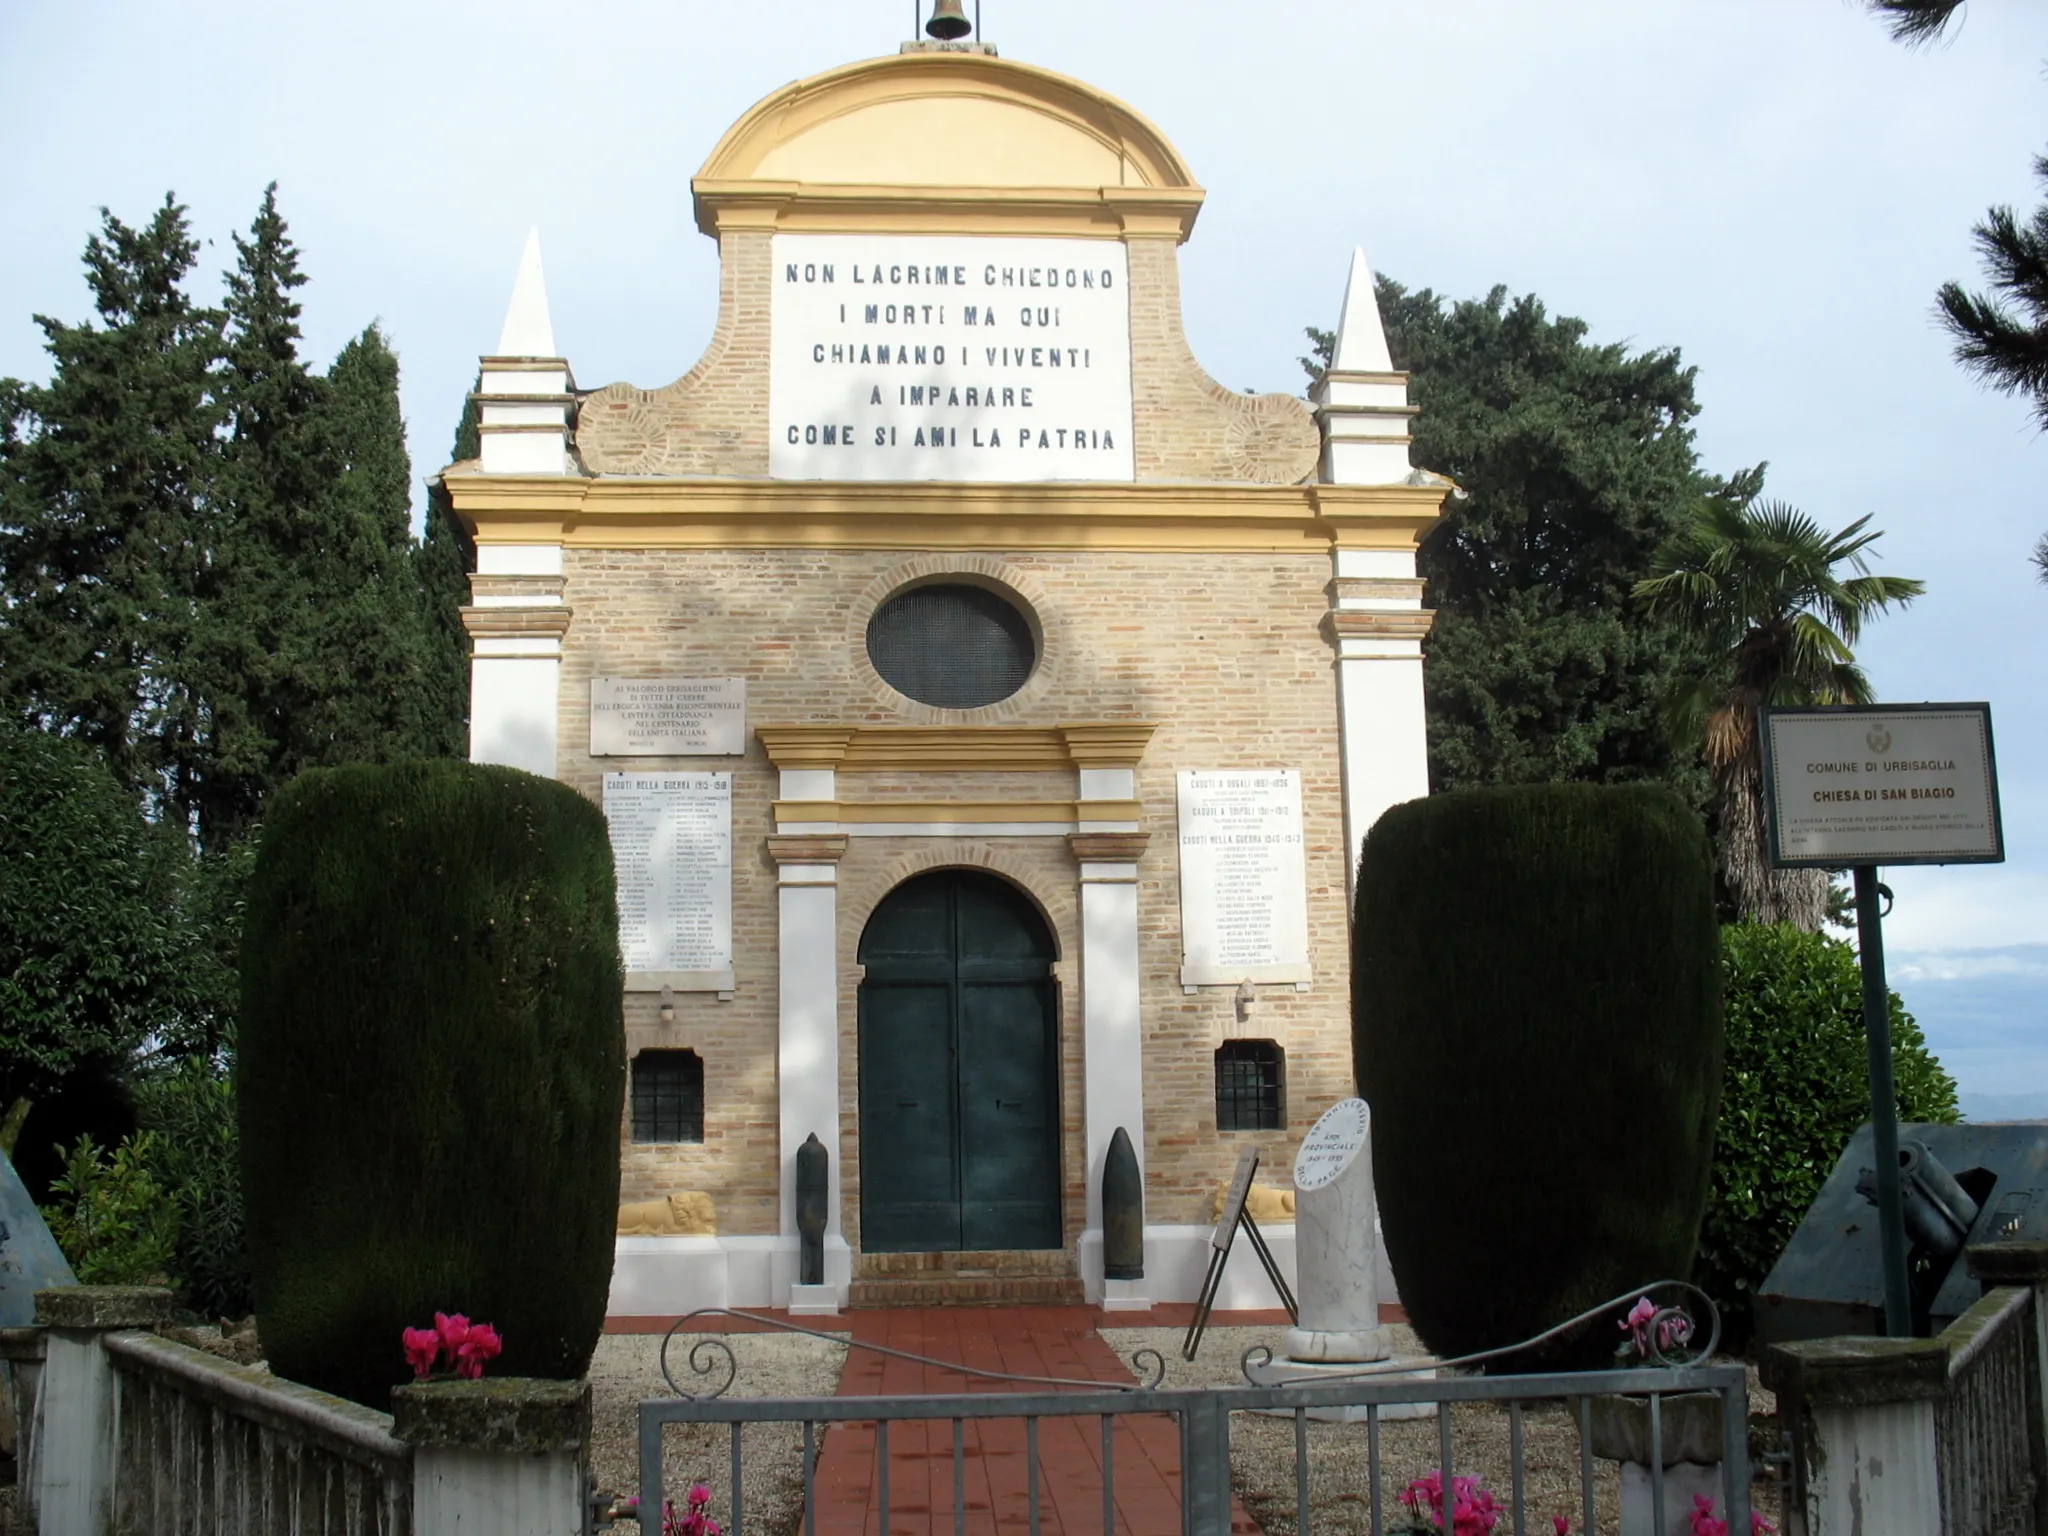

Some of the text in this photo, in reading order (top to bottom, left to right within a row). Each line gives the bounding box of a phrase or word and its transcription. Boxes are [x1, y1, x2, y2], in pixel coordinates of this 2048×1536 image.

[786, 264, 1112, 289] NON LACRIME CHIEDONO
[840, 304, 1060, 327] I MORTI MA QUI
[813, 344, 1090, 368] CHIAMANO I VIVENTI
[870, 385, 1033, 408] A IMPARARE
[787, 425, 1114, 450] COME SI AMI LA PATRIA
[1806, 760, 1956, 774] COMUNE DI URBISAGLIA
[607, 781, 632, 790] CADUTI
[637, 781, 658, 790] NELLA
[664, 781, 690, 790] GUERRA
[1191, 780, 1215, 789] CADUTI
[1227, 779, 1251, 788] DOGALI
[1813, 787, 1955, 802] CHIESA DI SAN BIAGIO
[1193, 807, 1217, 816] CADUTI
[1183, 836, 1207, 845] CADUTI
[1210, 835, 1232, 844] NELLA
[1235, 834, 1262, 844] GUERRA
[1304, 1143, 1355, 1151] PROVINCIALE
